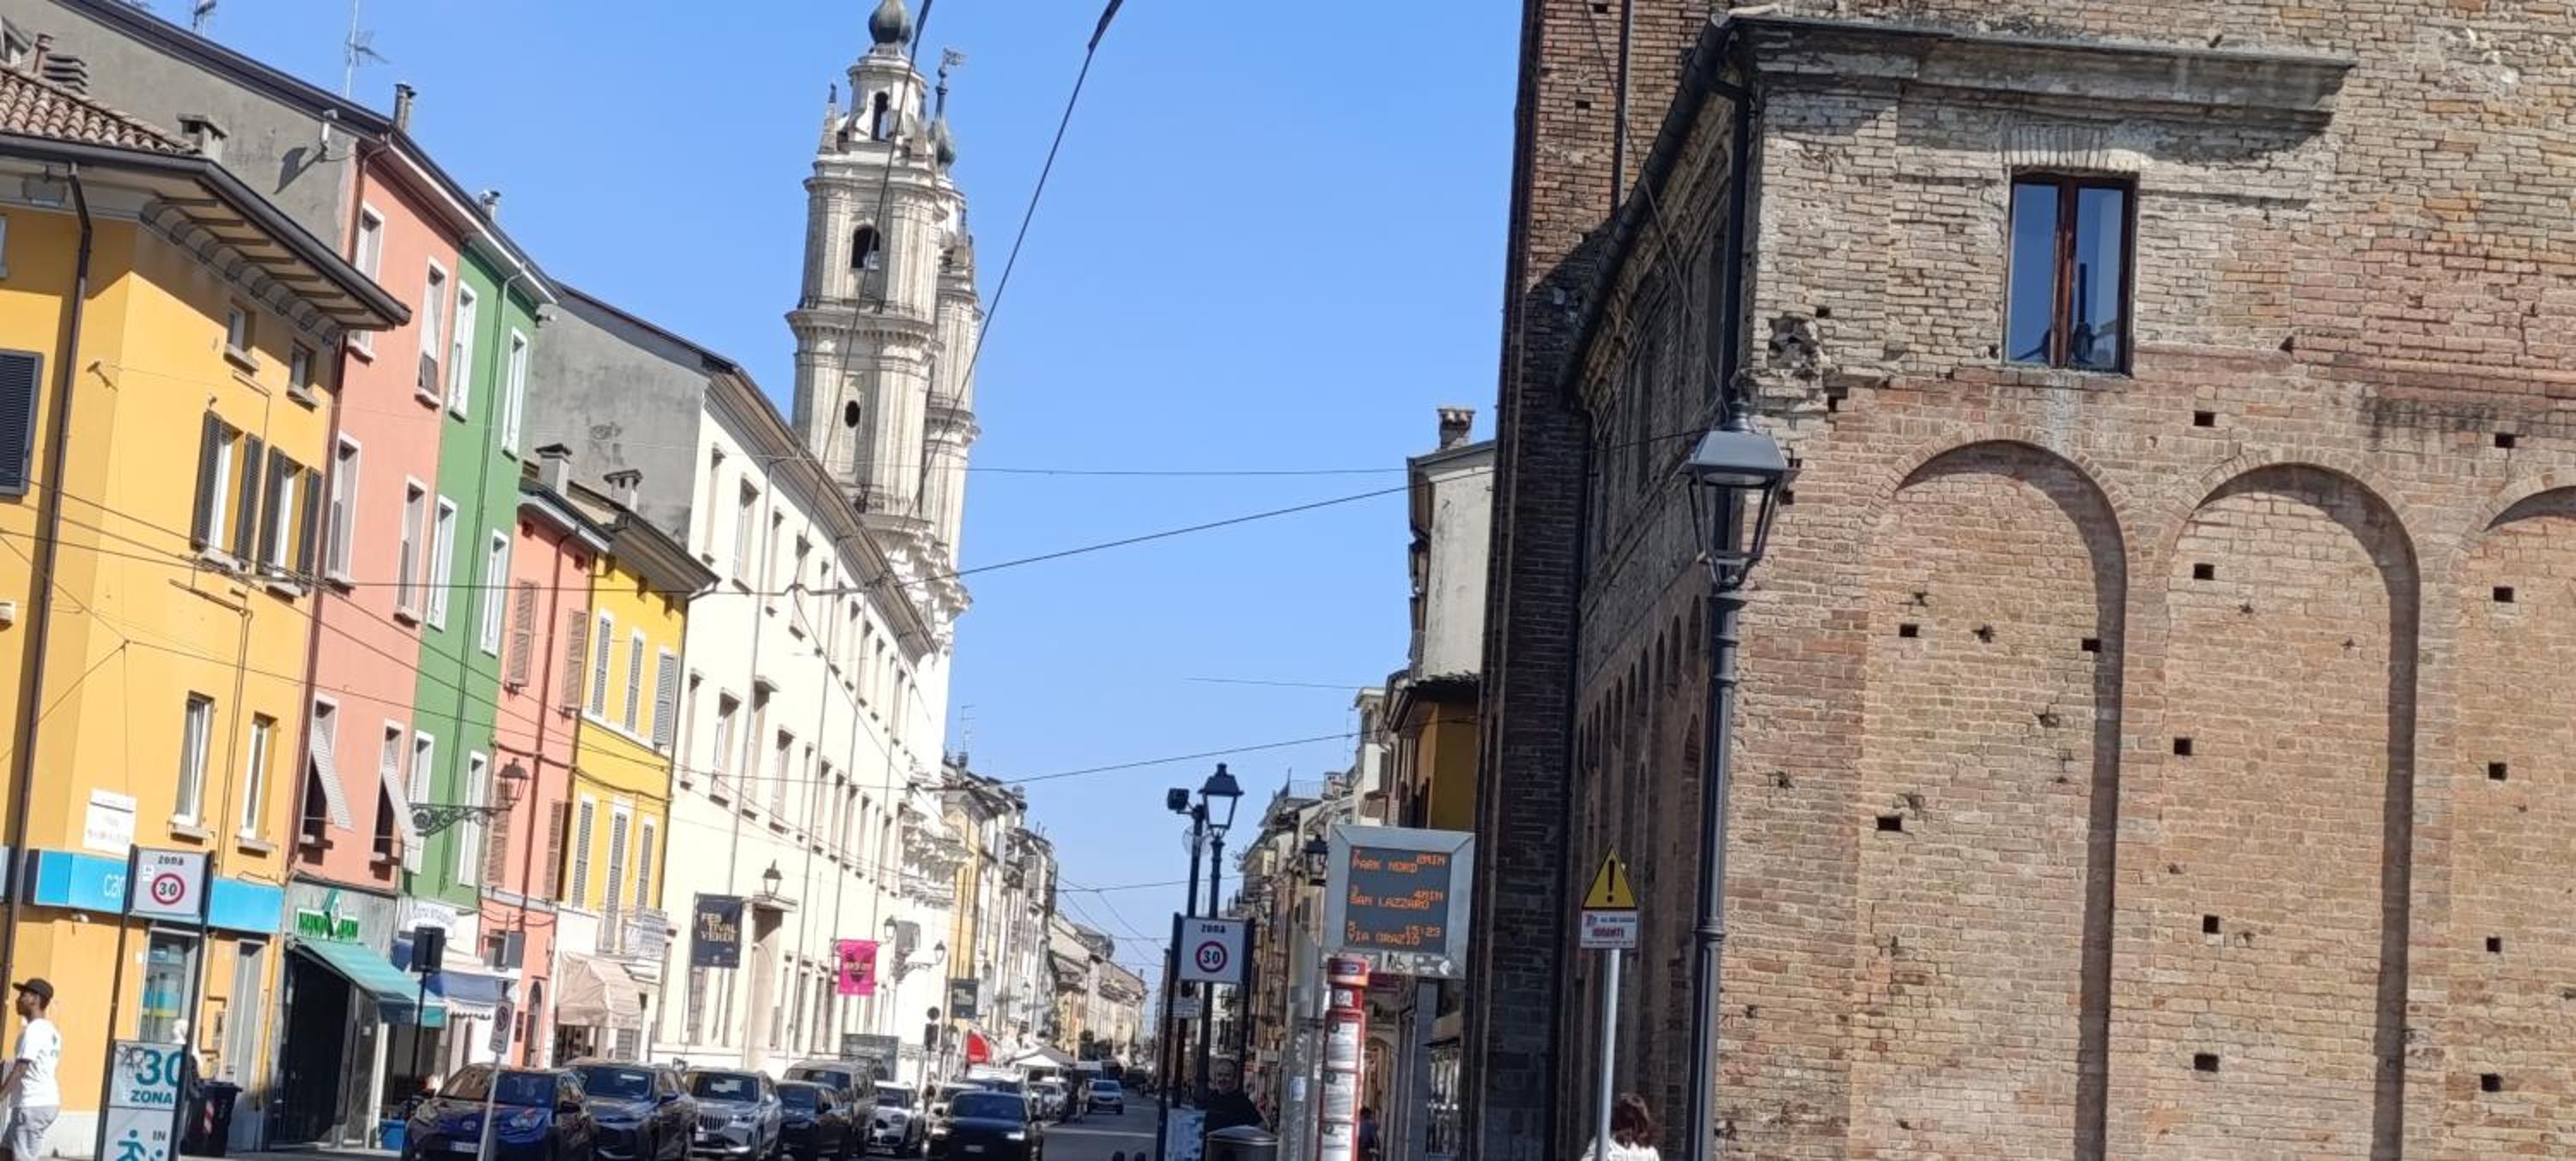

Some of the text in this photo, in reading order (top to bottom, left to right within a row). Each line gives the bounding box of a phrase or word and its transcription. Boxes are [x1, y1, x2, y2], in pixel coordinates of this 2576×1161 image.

[1352, 859, 1418, 873] PARK NORD
[159, 883, 178, 896] 30
[1349, 895, 1430, 910] SAN LAZZARO
[1203, 951, 1220, 963] 30
[130, 1090, 173, 1104] ZONA
[152, 1130, 167, 1141] IN
